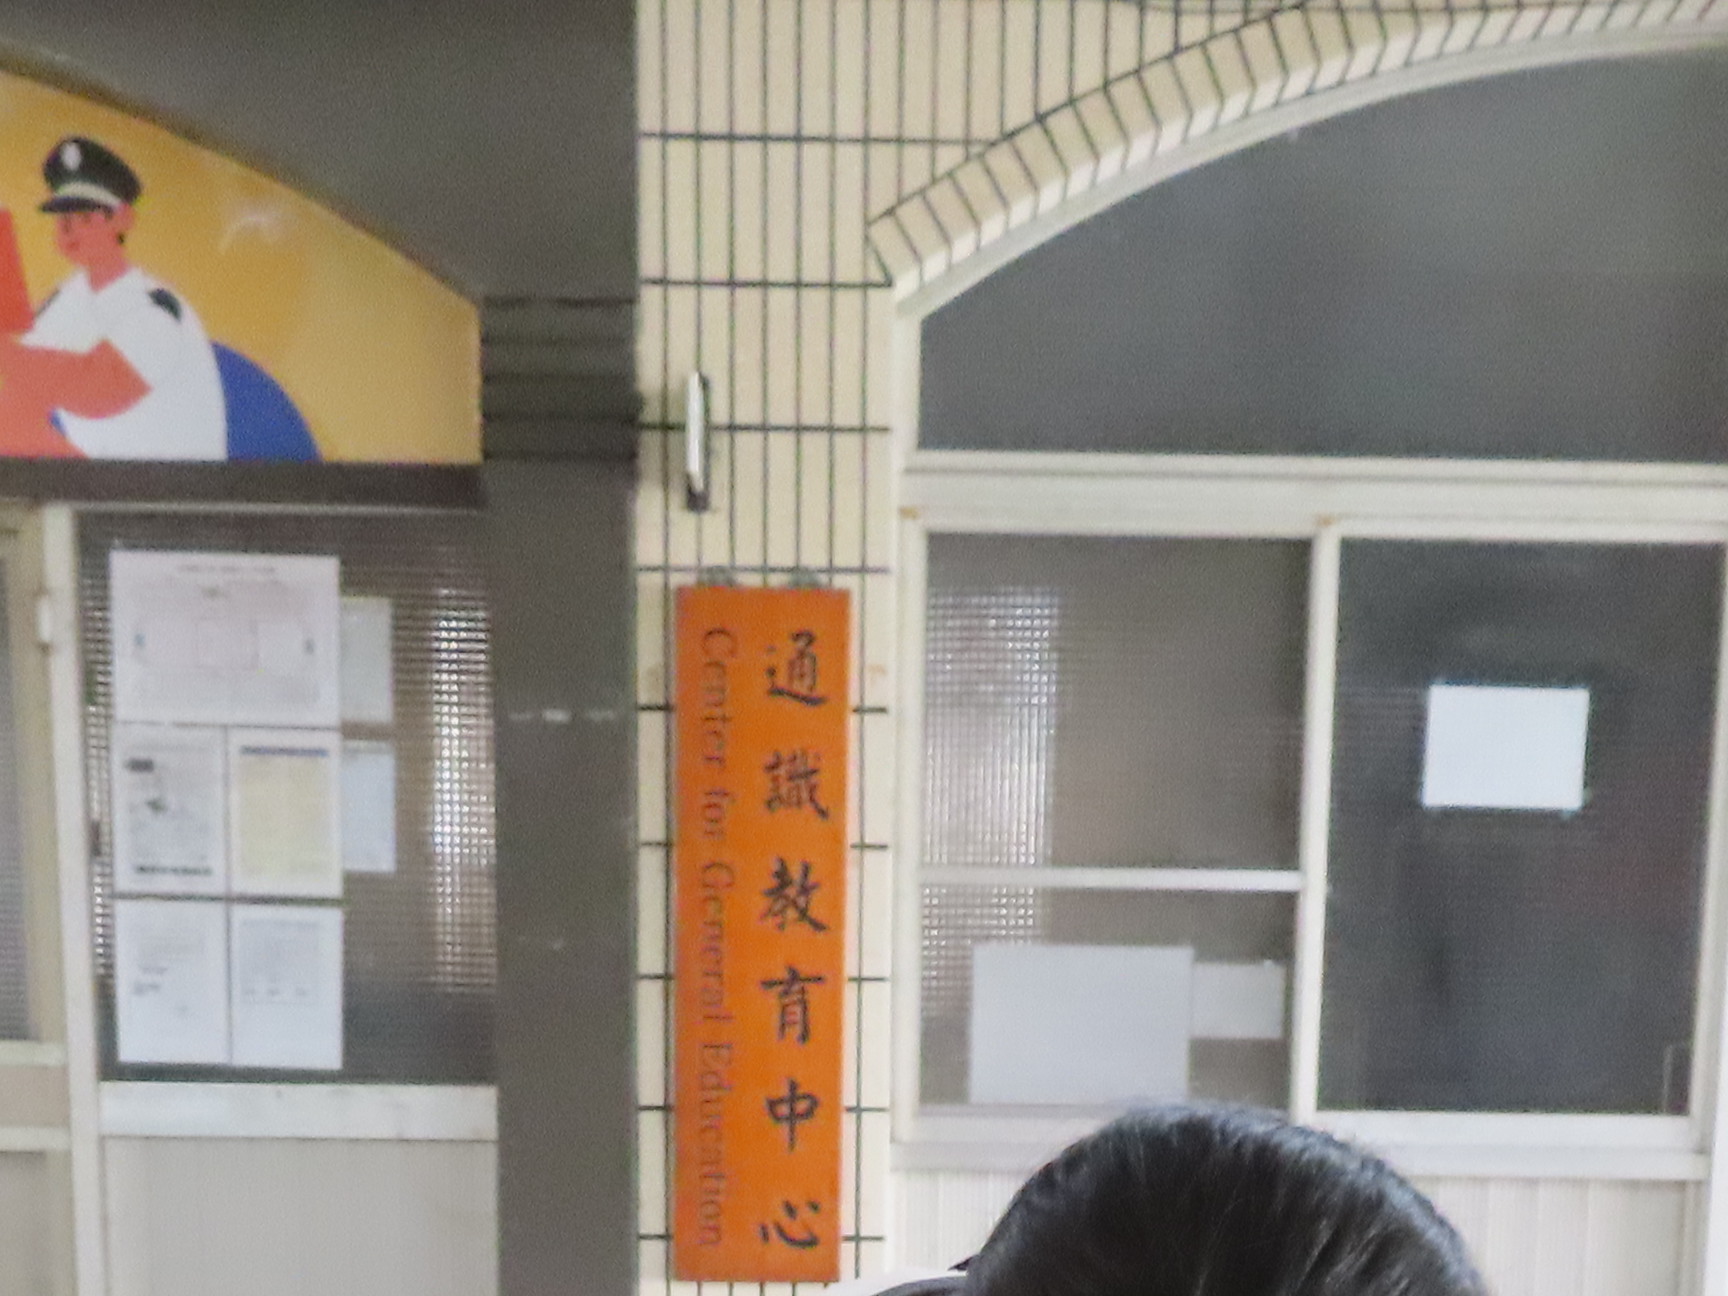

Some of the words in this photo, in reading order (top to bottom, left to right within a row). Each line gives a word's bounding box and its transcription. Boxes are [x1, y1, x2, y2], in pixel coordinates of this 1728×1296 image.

[700, 627, 739, 767] Center
[702, 788, 737, 838] for
[699, 861, 737, 1022] General
[758, 628, 830, 1250] 通識教育中心
[699, 1043, 734, 1246] Education
